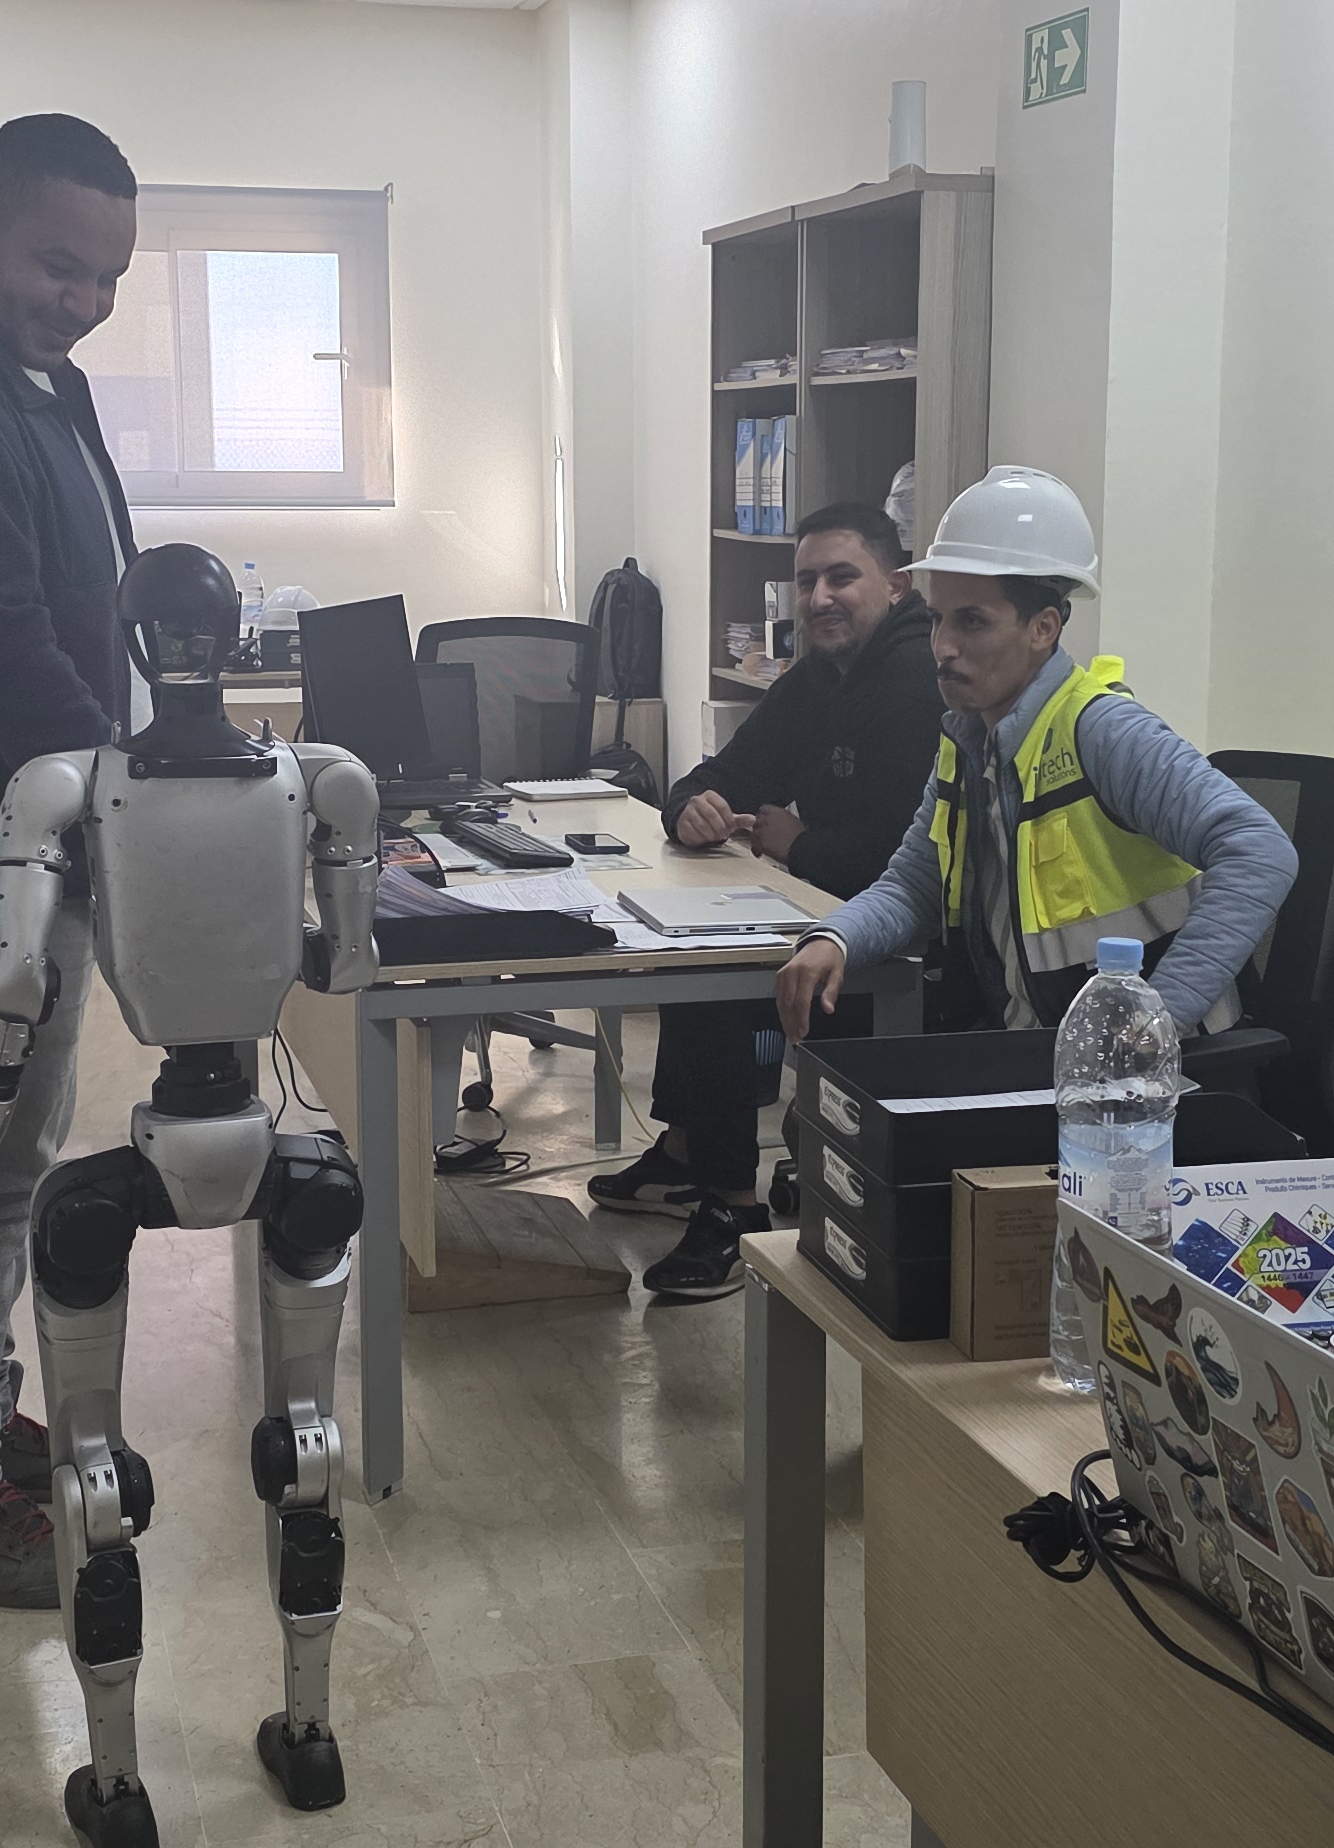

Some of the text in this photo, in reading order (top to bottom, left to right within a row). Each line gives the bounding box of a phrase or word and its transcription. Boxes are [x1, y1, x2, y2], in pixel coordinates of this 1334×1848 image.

[1255, 1176, 1288, 1186] Instruments
[1297, 1175, 1317, 1183] Mesure
[1204, 1181, 1248, 1197] ESCA
[1265, 1184, 1288, 1193] Produits
[1288, 1183, 1317, 1192] Chimiques
[1257, 1246, 1311, 1272] 2025
[1293, 1272, 1314, 1281] 1447
